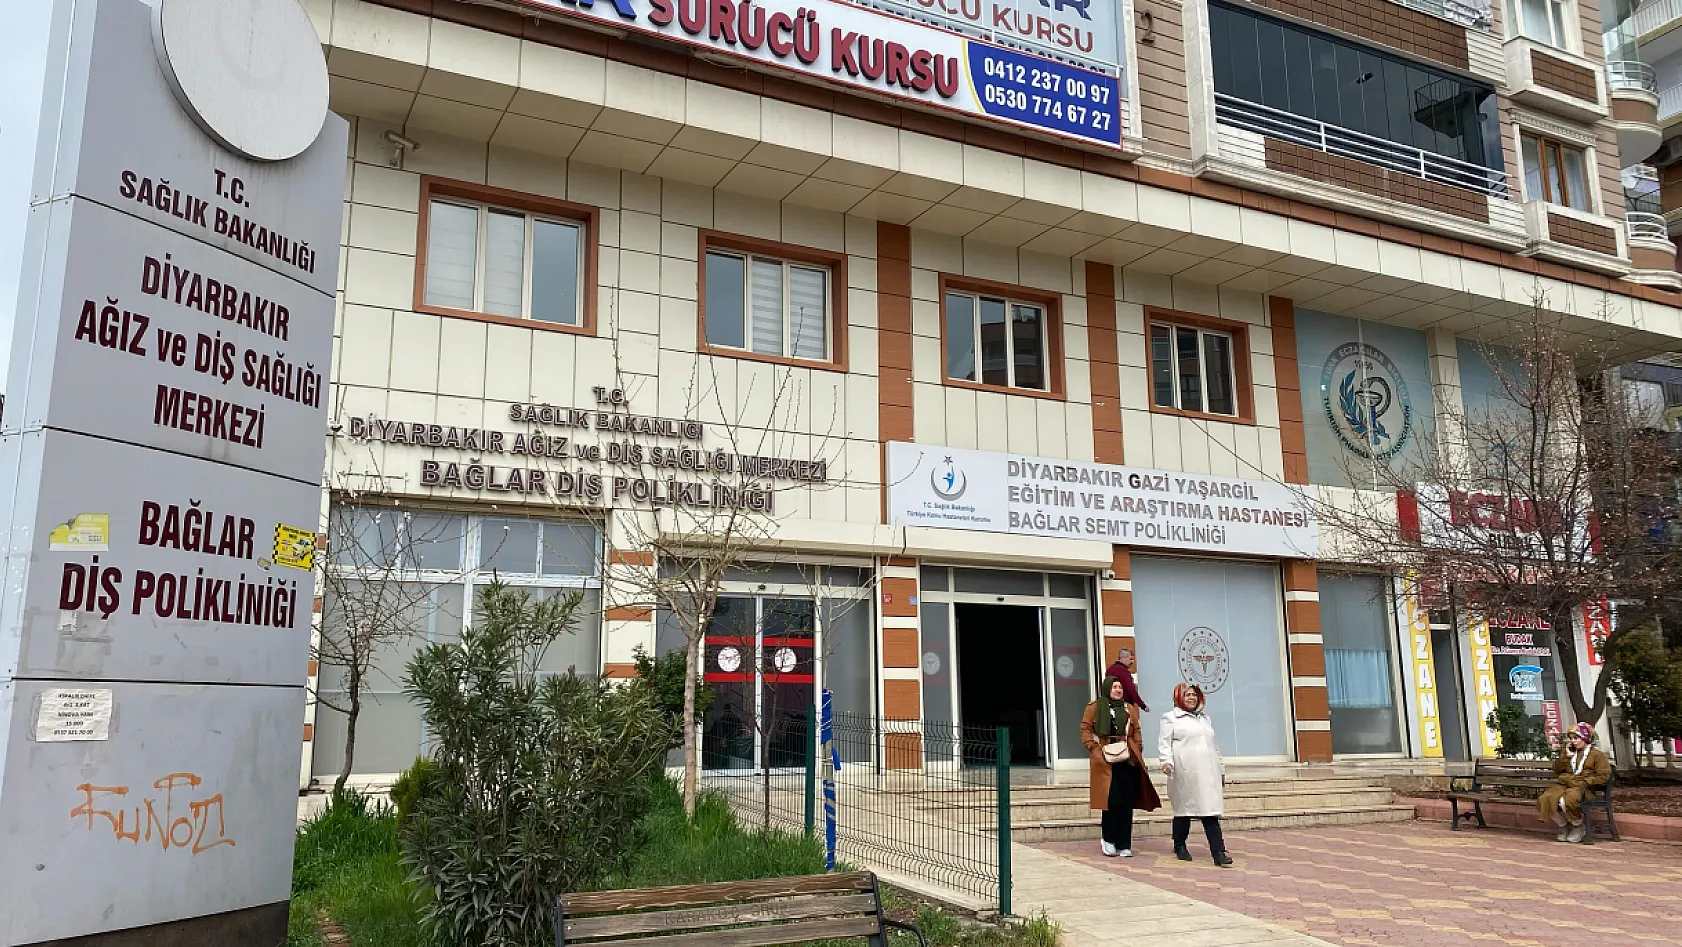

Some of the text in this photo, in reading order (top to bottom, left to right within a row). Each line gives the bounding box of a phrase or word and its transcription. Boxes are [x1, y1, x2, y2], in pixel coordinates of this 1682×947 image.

[992, 3, 1093, 53] KURSU
[831, 27, 959, 98] KURSU
[984, 57, 1110, 105] 0412 237 00 97
[985, 84, 1112, 131] 0530 774 67 27
[214, 168, 250, 208] T.C.
[119, 170, 316, 274] SAĞLIK BAKANLIĞI
[141, 252, 290, 342] DİYARBAKIR
[75, 295, 322, 409] AĞIZ ve DİŞ SAĞLIĞI
[153, 384, 265, 449] MERKEZİ
[510, 403, 703, 440] SAĞLIK BAKANLIĞI
[350, 412, 827, 483] DİYARBAKIR AĞIZ ve DİŞ SAĞLIĞI MERKEZİ
[420, 457, 775, 513] BAĞLAR DİŞ POLİKLİNİĞİ
[1007, 458, 1259, 501] DİYARBAKIR GAZİ YAŞARGİL
[1007, 483, 1309, 528] EĞİTİM VE ARAŞTIRMA HASTANESİ
[138, 498, 255, 560] BAĞLAR
[1009, 509, 1226, 545] BAĞLAR SEMT POLİKLİNİĞİ
[59, 555, 297, 629] DİŞ POLİKLİNİĞİ
